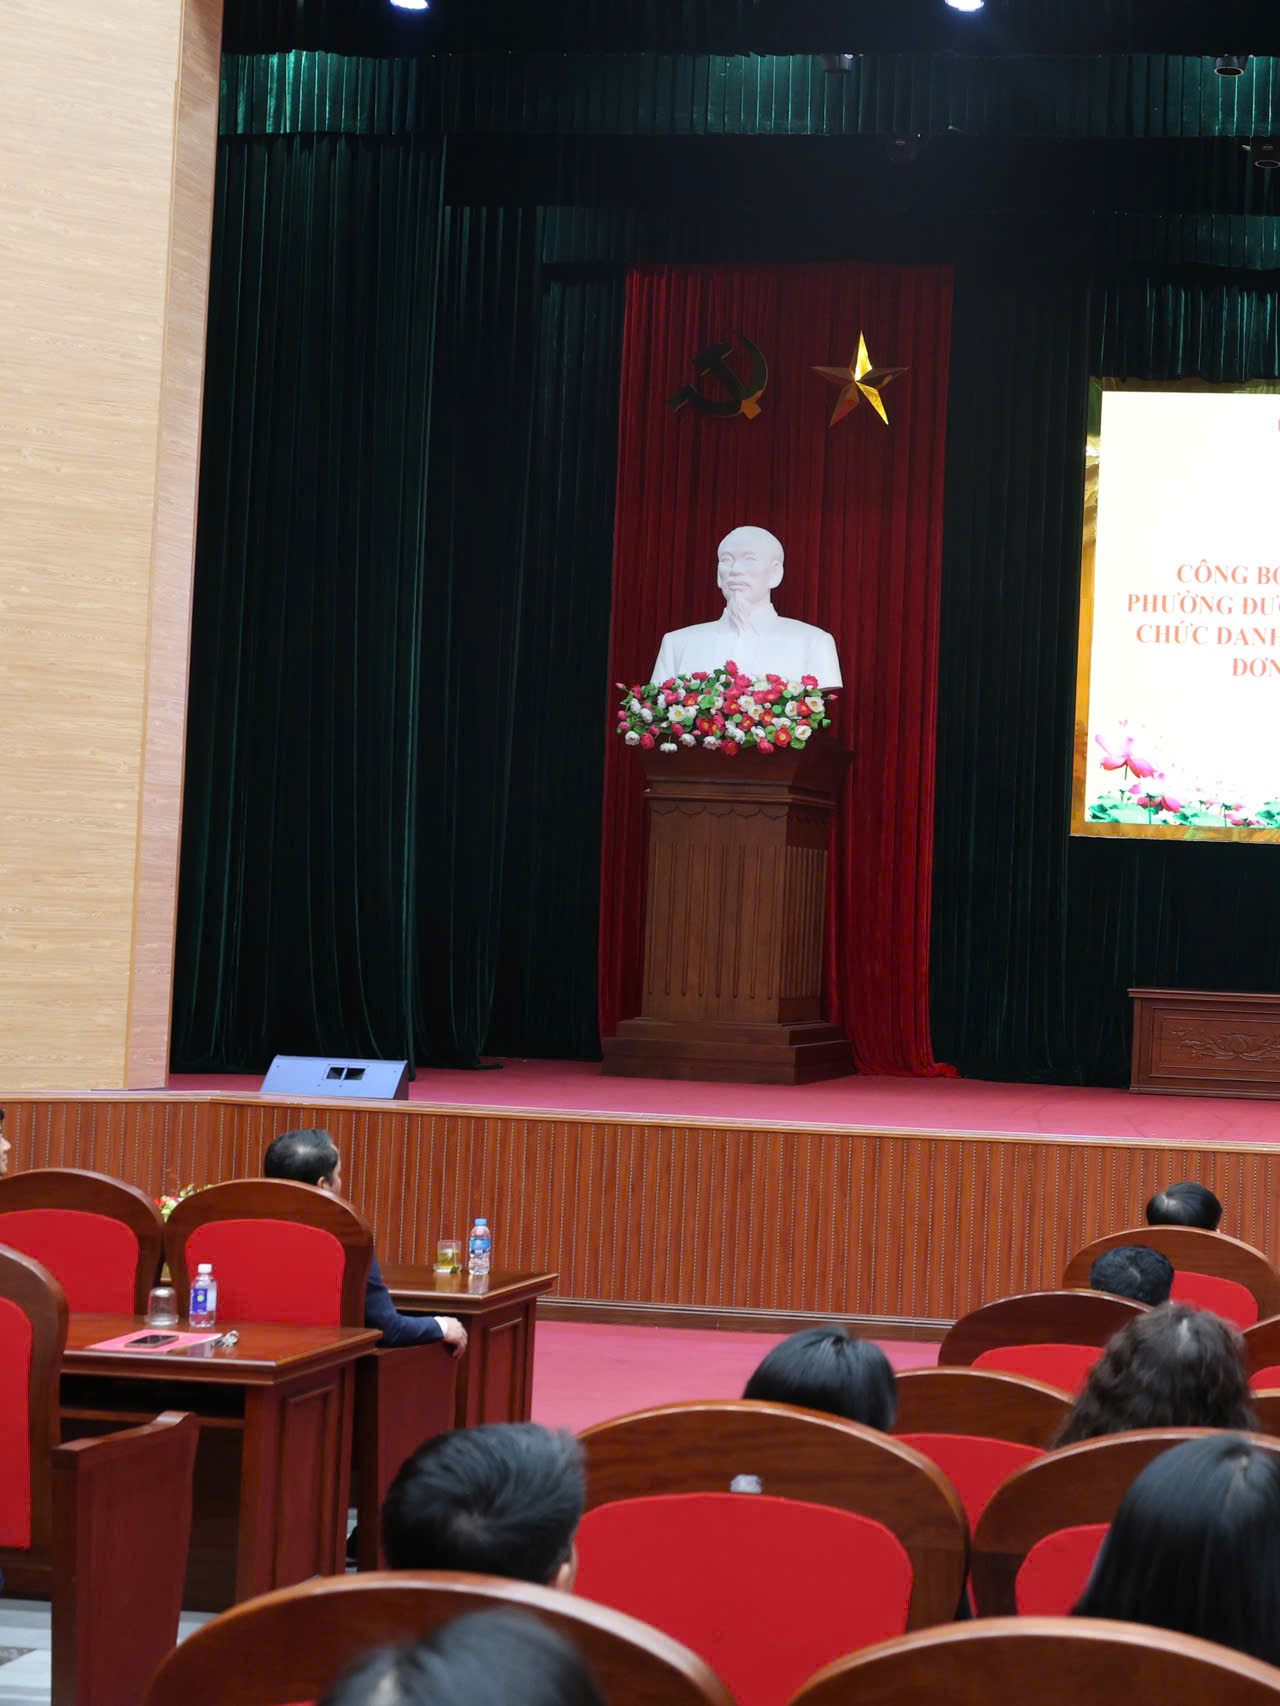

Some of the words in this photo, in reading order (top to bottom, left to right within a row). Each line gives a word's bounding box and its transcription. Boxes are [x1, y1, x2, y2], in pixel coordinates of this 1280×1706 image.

[1177, 559, 1248, 584] CÔNG
[1128, 590, 1232, 614] PHƯỜNG
[1136, 621, 1208, 645] CHỨC
